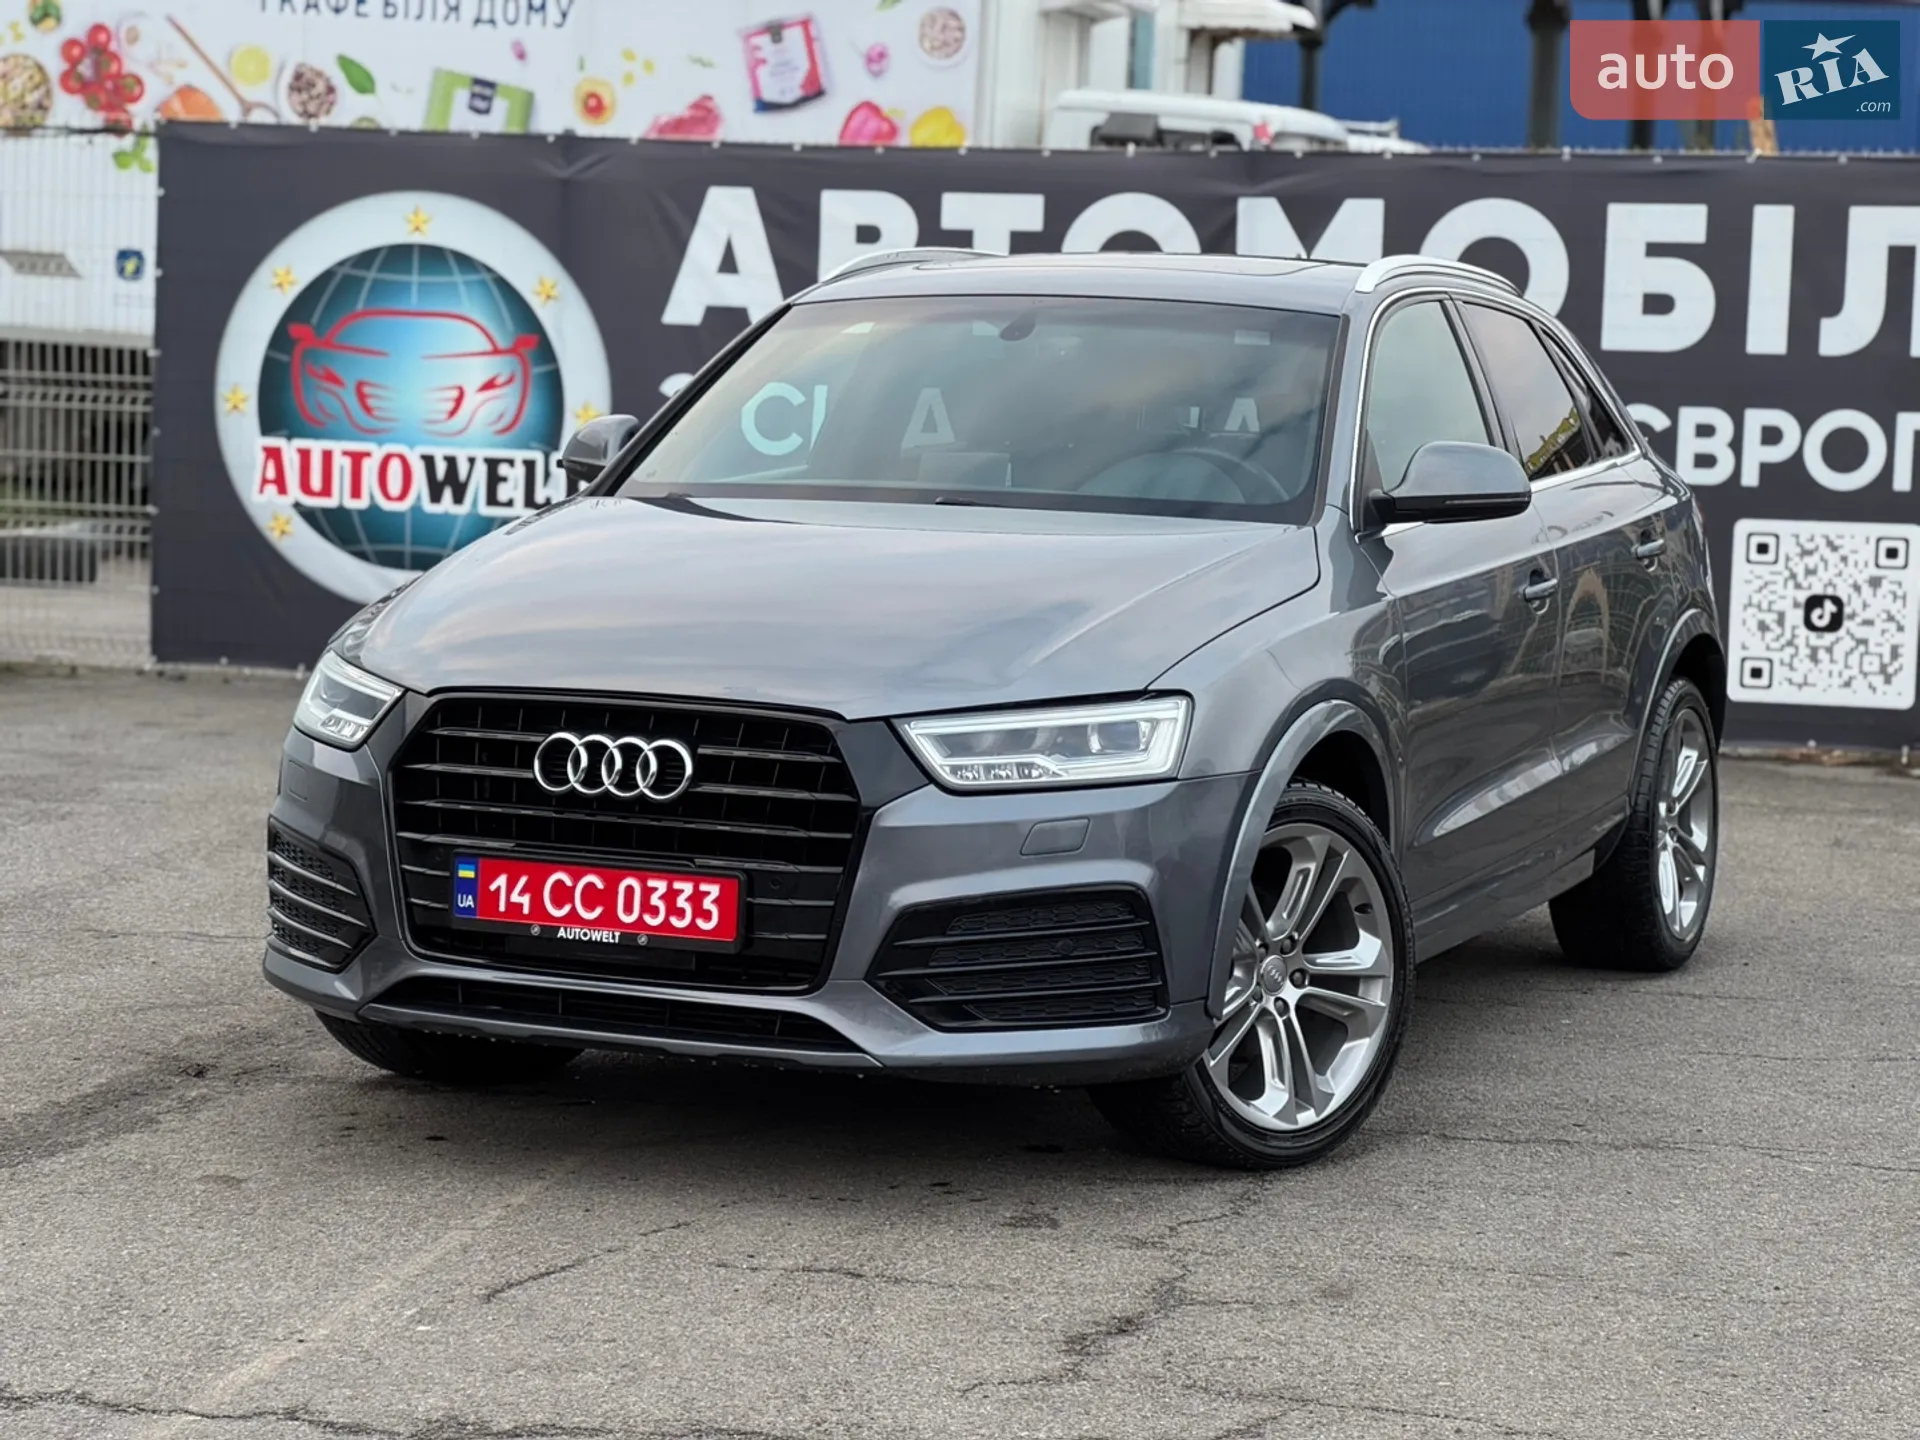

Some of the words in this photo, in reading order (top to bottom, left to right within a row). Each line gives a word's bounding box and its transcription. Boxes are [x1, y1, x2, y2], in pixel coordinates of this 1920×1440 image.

[473, 0, 575, 29] ДОМУ
[457, 893, 475, 909] UA
[488, 873, 532, 915] 14
[543, 871, 605, 920] CC
[616, 876, 721, 931] 0333
[556, 926, 621, 944] AUTOWELT
